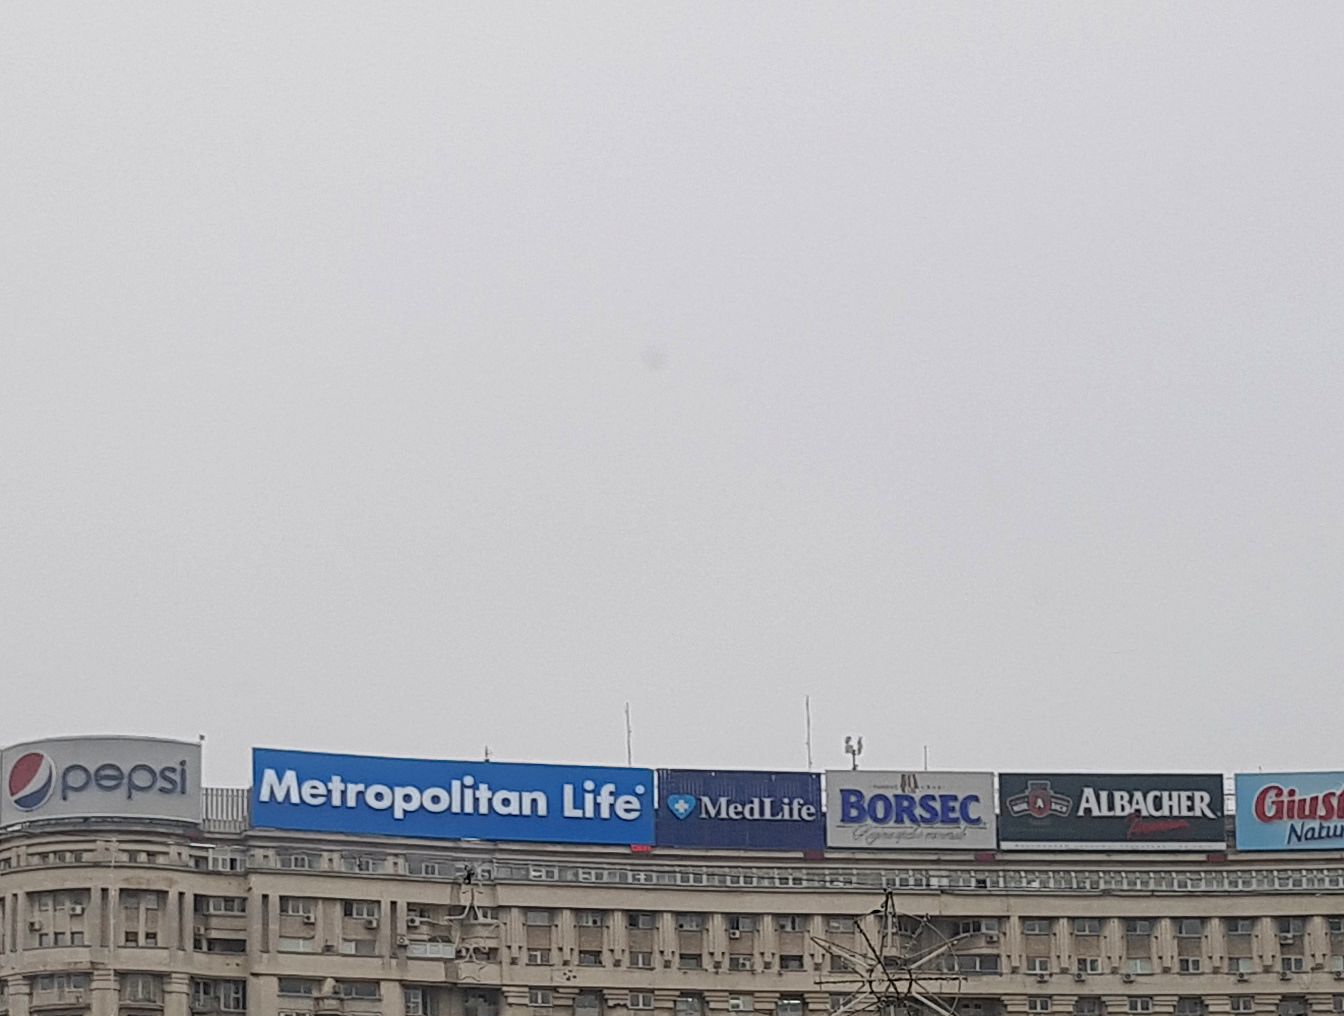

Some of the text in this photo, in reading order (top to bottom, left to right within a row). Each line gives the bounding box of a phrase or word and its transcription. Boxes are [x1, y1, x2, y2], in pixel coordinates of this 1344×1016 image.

[61, 760, 187, 801] pepsi
[258, 768, 549, 820] Metropolitan
[699, 796, 816, 821] MedLife
[839, 788, 982, 826] BORSEC
[1076, 787, 1218, 819] ALBACHER
